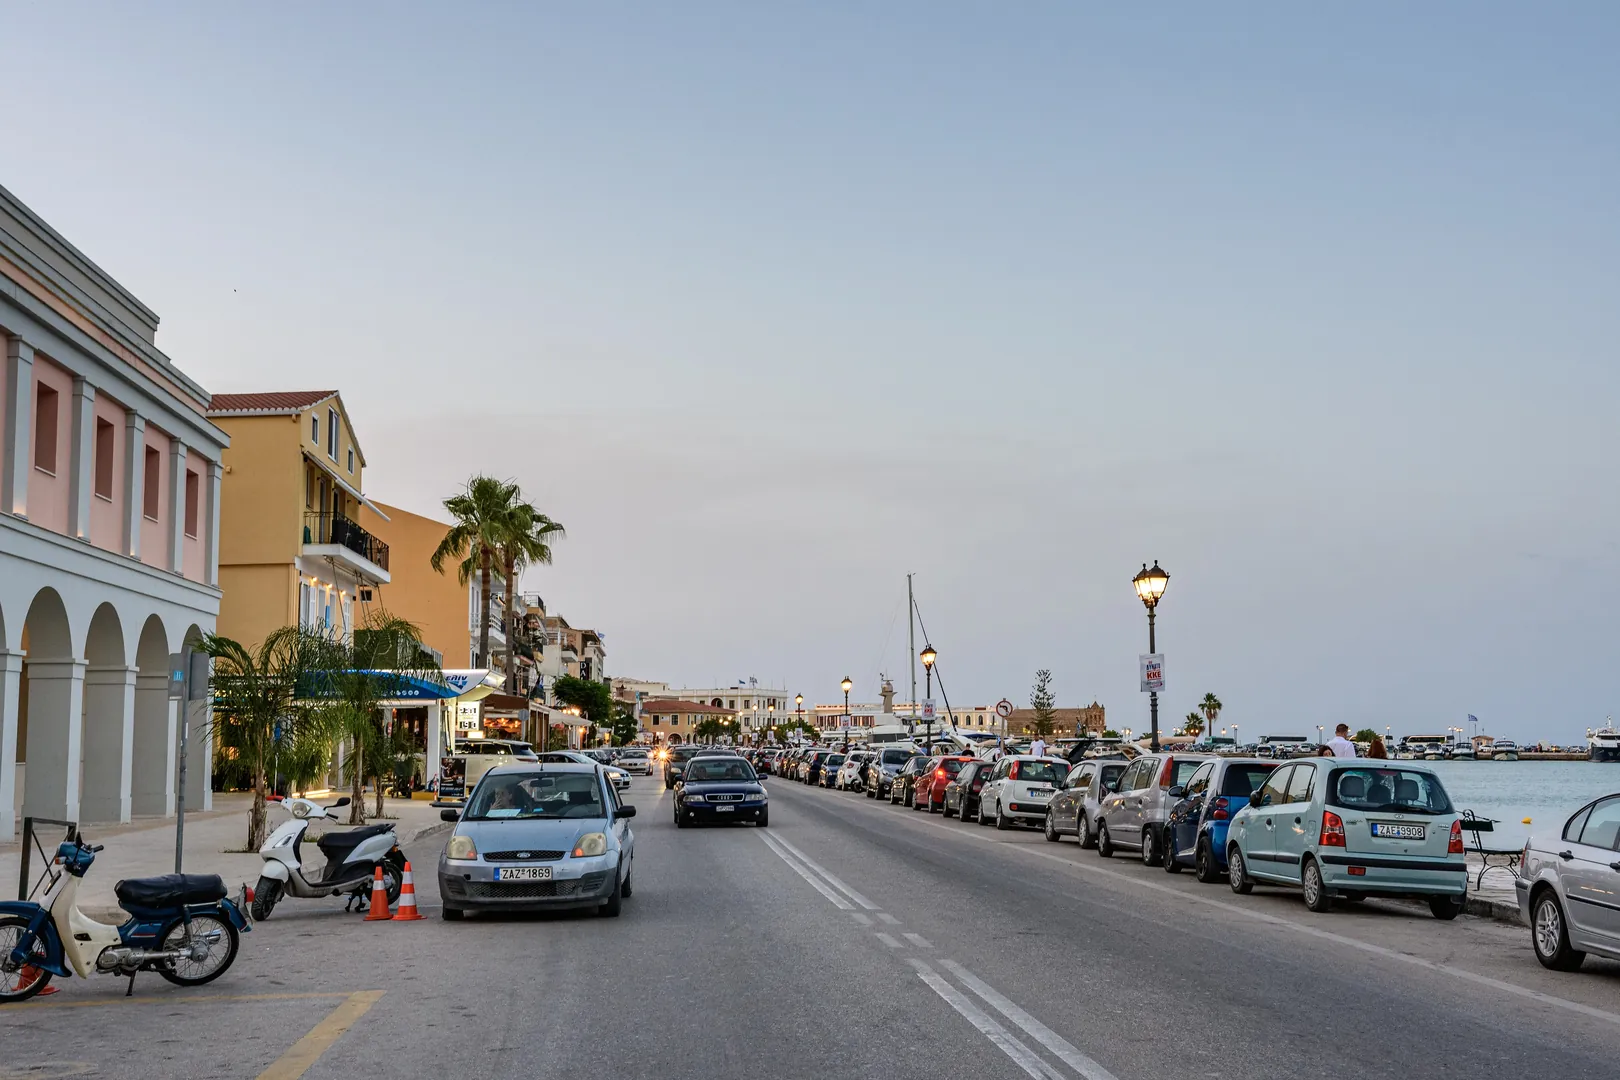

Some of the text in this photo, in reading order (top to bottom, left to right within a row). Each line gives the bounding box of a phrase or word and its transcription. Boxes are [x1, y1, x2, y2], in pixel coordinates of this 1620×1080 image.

[1380, 825, 1423, 837] ZAE 9908
[502, 868, 551, 879] ZAZ 1869
